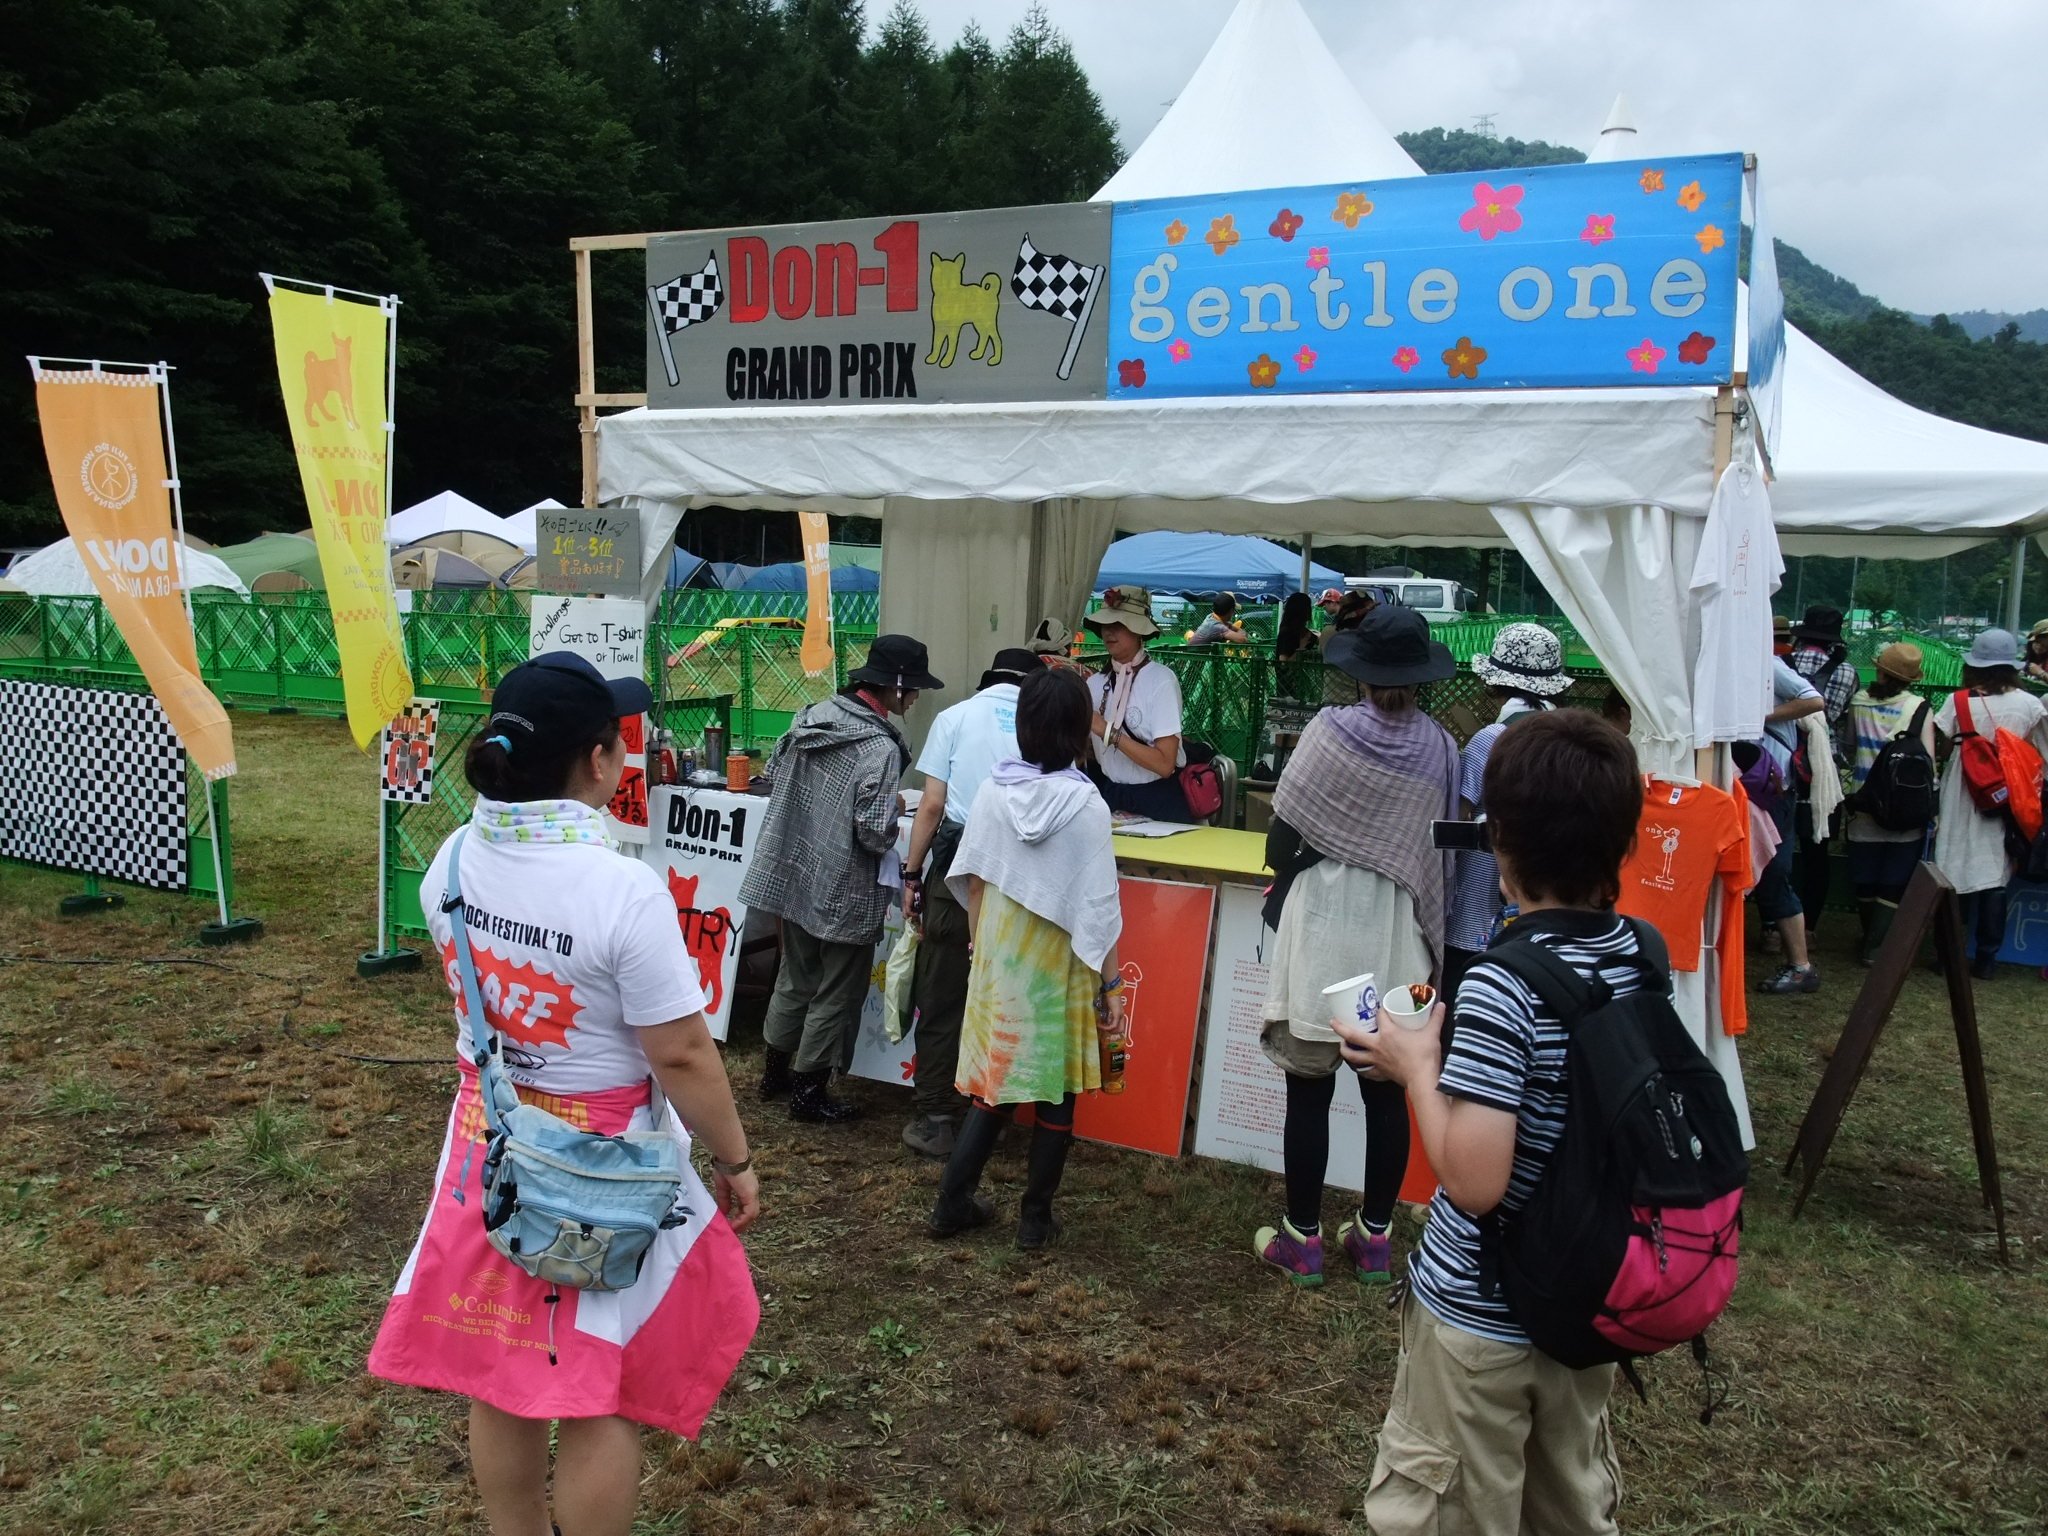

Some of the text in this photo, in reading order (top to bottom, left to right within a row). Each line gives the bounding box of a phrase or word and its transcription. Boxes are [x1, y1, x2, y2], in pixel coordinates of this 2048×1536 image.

[727, 221, 919, 323] Don-1
[1129, 252, 1707, 343] gentle one
[726, 342, 917, 400] GRAND PRIX
[559, 623, 642, 644] Get to T-shirt
[596, 646, 638, 663] or Towel
[667, 794, 747, 848] Don-1
[665, 838, 743, 863] GRAND PRIX
[678, 865, 744, 956] TRY
[492, 915, 549, 950] FESTIVAL
[448, 959, 560, 1028] SAFF
[510, 1071, 537, 1085] BEAMS
[462, 1316, 477, 1326] WE
[463, 1296, 532, 1325] Columbia
[520, 1339, 533, 1348] OF
